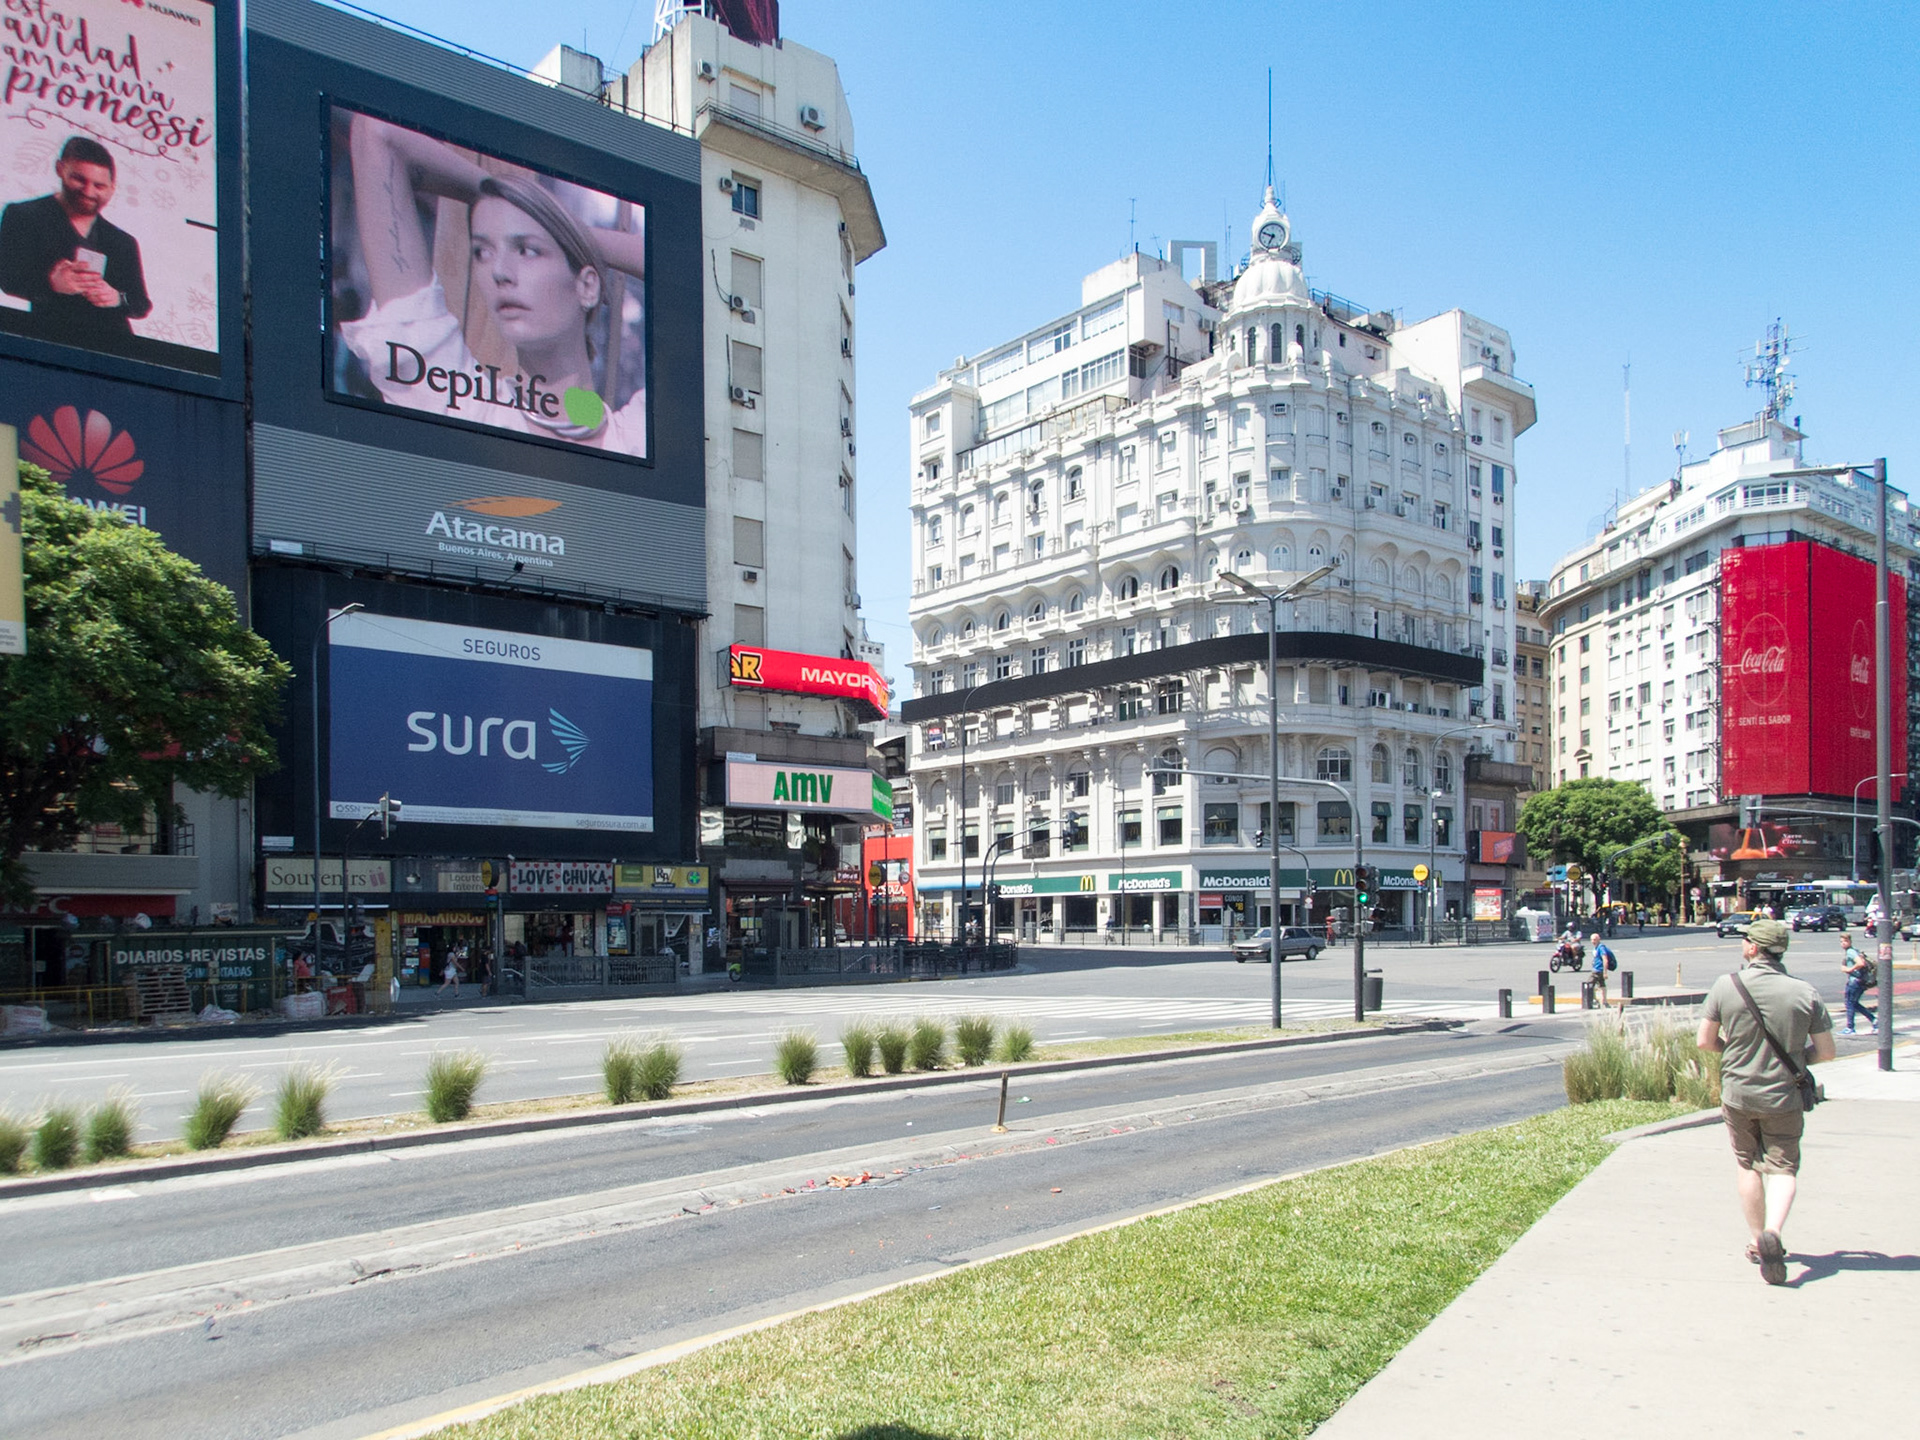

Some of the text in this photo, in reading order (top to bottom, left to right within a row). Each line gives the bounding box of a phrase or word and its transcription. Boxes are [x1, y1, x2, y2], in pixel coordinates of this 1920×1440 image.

[149, 3, 201, 27] HUAWEI
[5, 65, 211, 148] promessi
[385, 340, 560, 418] DepiLife
[425, 511, 565, 555] Atacama
[438, 541, 554, 567] Buenos Aires, Argentina
[463, 638, 541, 661] SEGUROS
[1768, 715, 1791, 724] SABOR
[407, 711, 536, 760] sura
[576, 817, 648, 829] segurossura.com.ar
[271, 865, 367, 886] Souvenrs
[518, 868, 554, 885] LOVE
[562, 868, 608, 886] CHUKA
[1117, 877, 1171, 890] McDonald's
[1000, 883, 1033, 894] Donald's
[116, 948, 266, 965] DIARIOS REVISTAS
